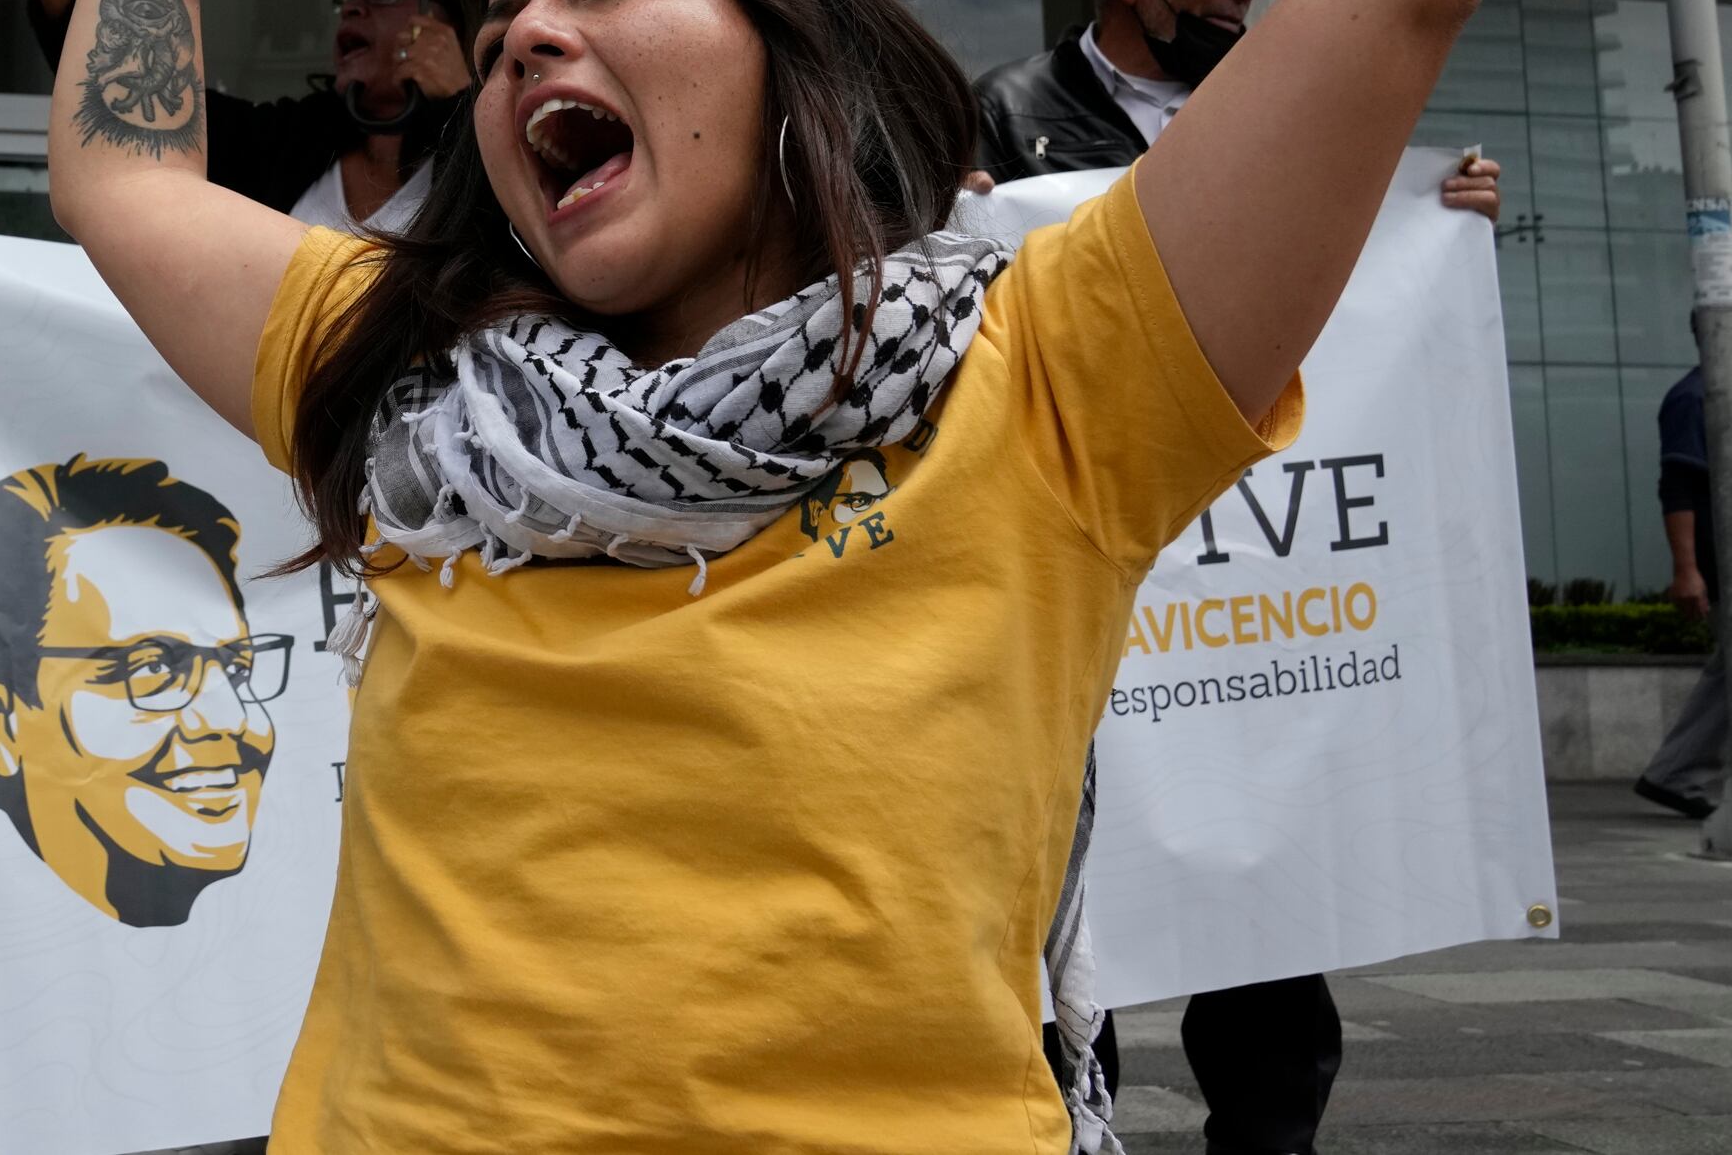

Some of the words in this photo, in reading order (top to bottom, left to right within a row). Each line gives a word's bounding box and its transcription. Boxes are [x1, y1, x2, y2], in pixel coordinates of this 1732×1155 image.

[824, 511, 895, 559] VE
[1196, 453, 1389, 566] IVE
[1120, 582, 1378, 659] AVICENCIO
[1110, 644, 1402, 723] esponsabilidad
